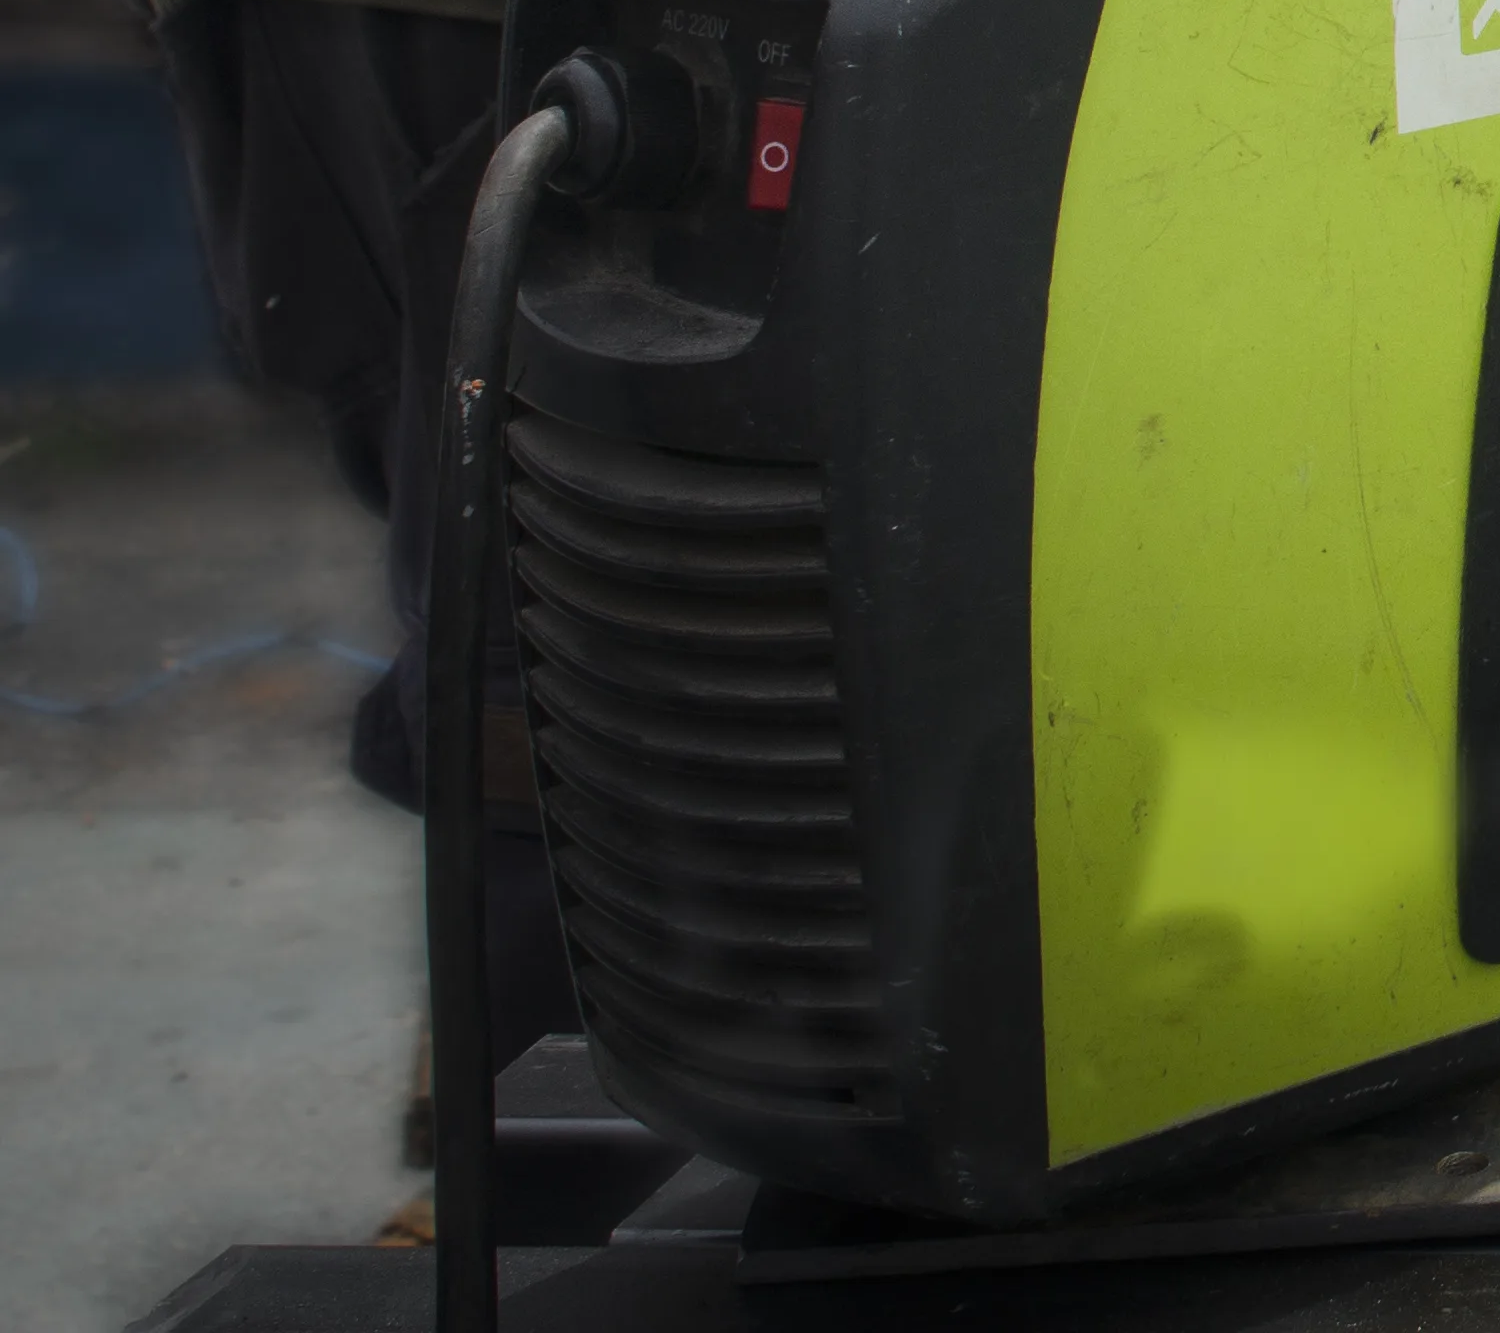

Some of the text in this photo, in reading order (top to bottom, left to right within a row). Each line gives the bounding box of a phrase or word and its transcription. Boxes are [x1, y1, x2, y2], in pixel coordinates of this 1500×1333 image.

[661, 7, 731, 41] AC 220V
[757, 39, 792, 67] OFF
